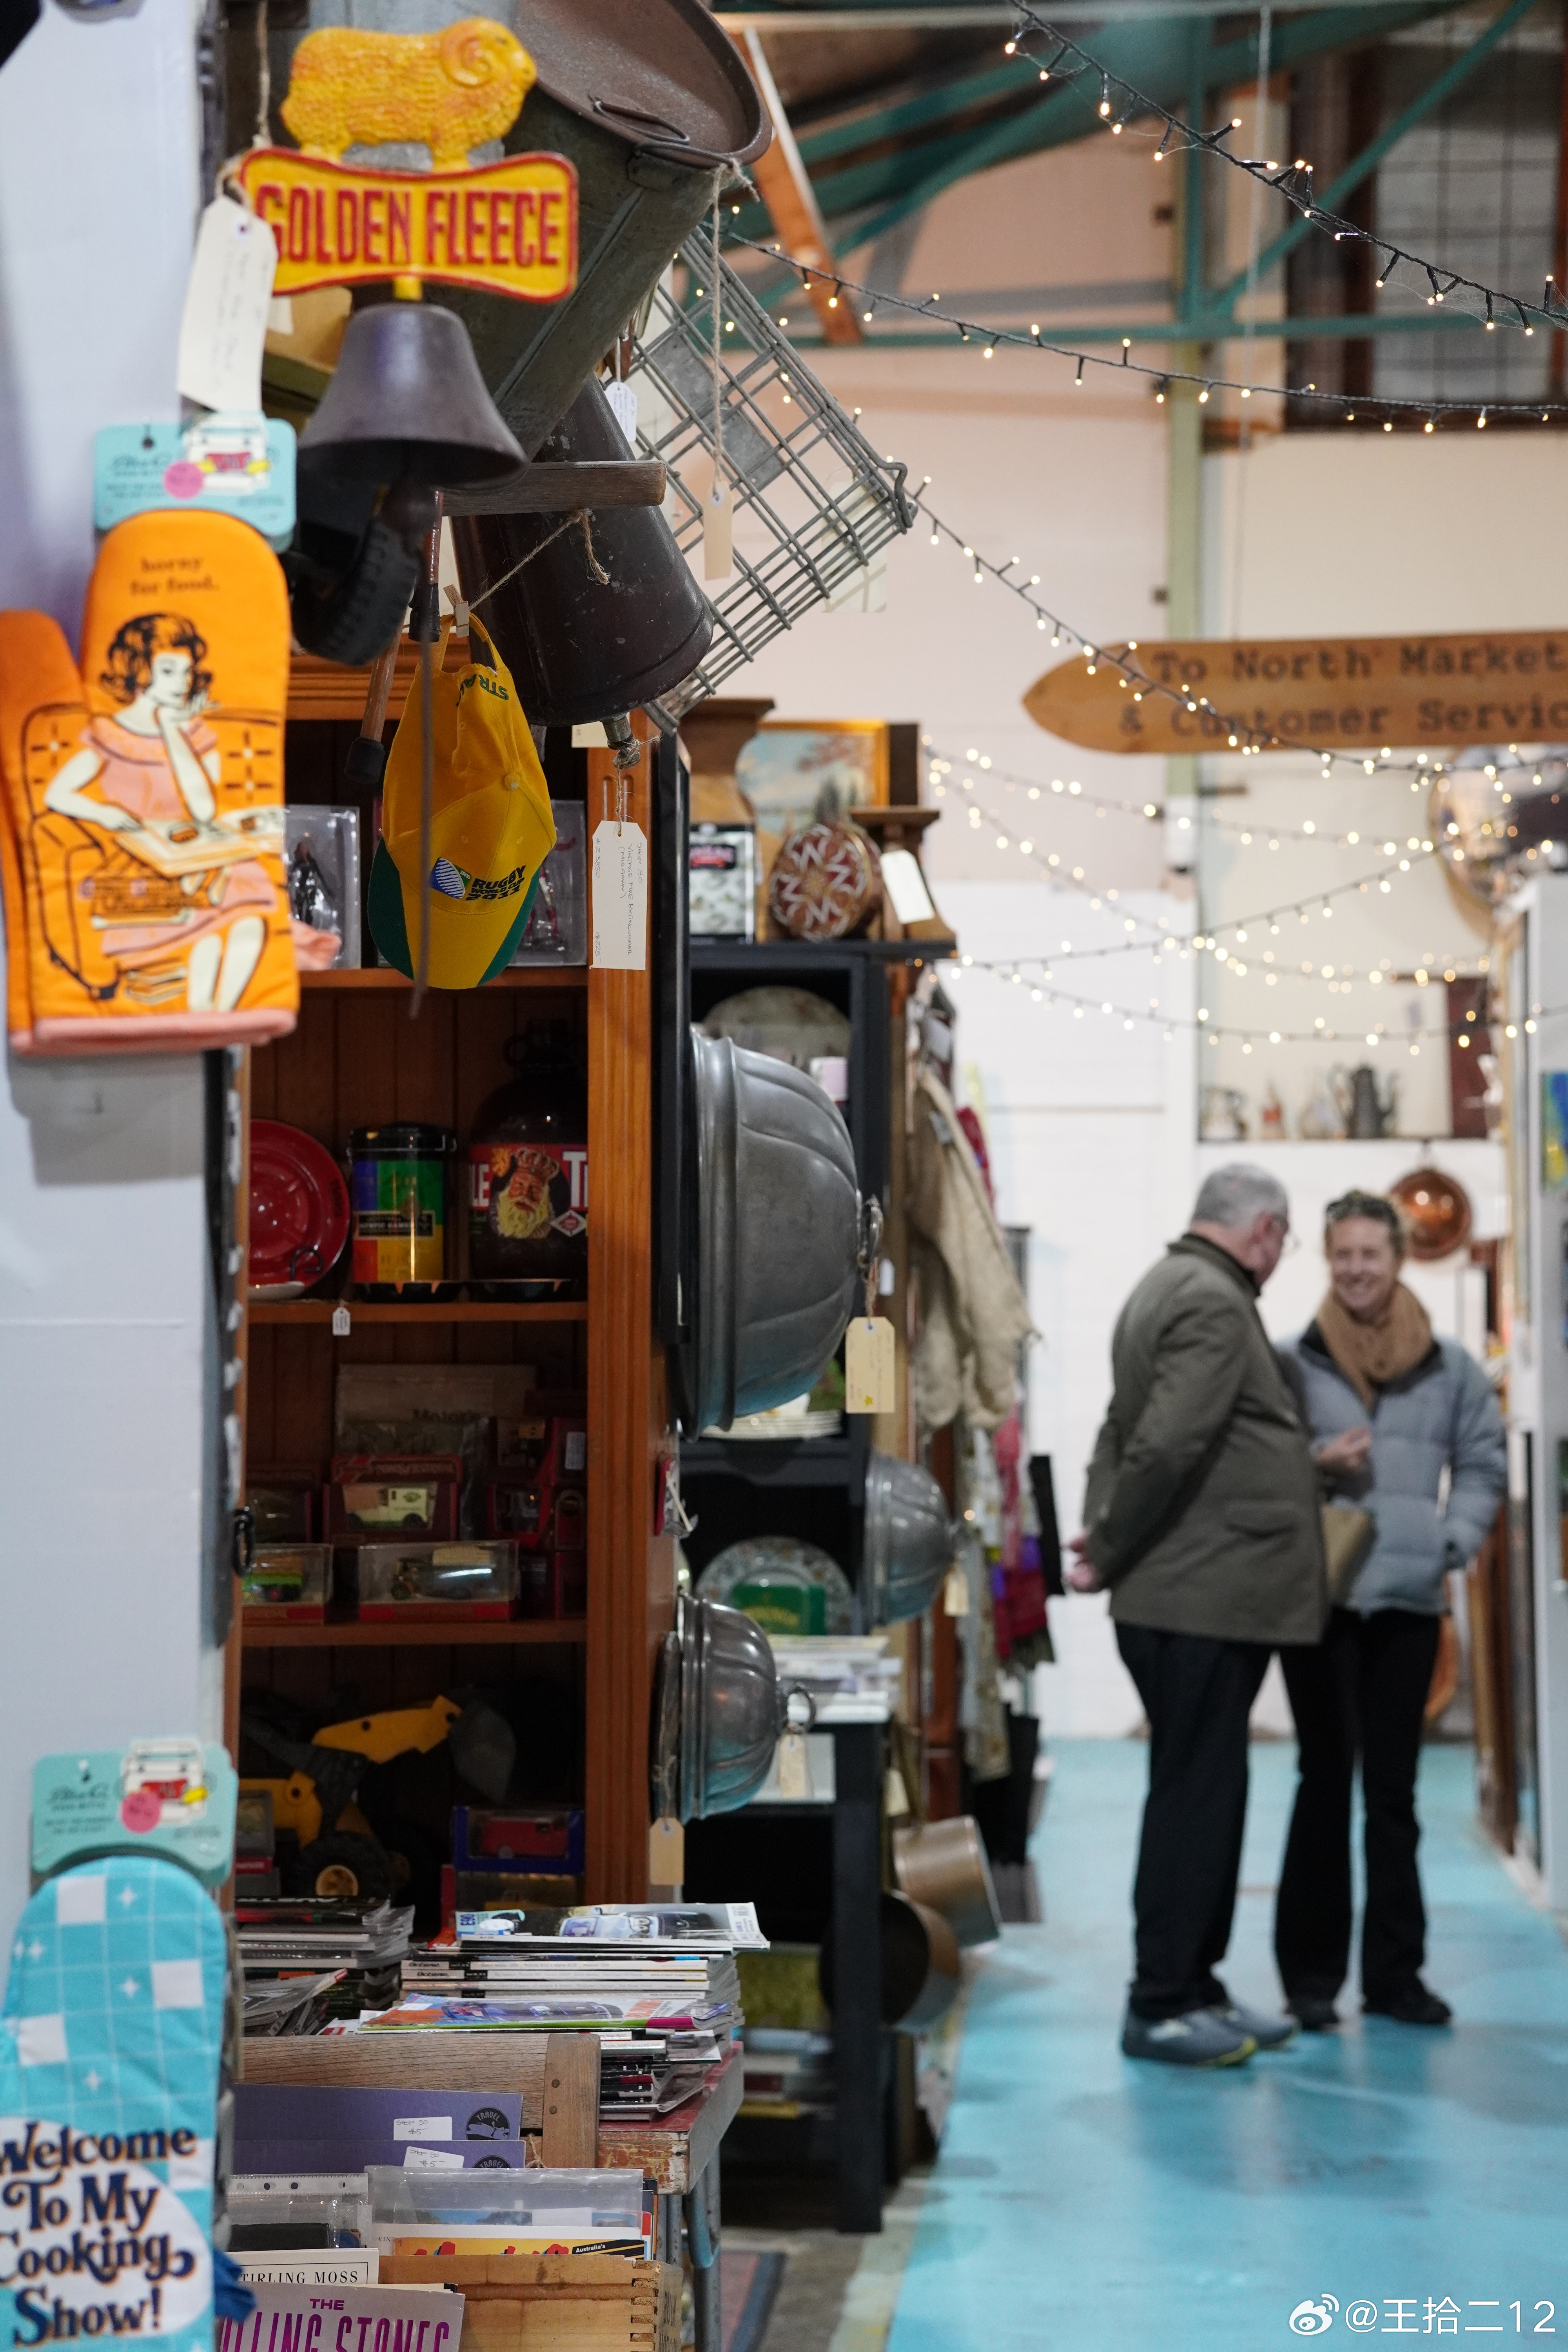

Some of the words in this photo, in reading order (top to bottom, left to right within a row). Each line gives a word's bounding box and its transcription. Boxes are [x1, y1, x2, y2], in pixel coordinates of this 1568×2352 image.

[255, 184, 412, 265] GOLDEN
[426, 190, 563, 267] FLEECE
[1152, 650, 1208, 684] To
[1233, 645, 1371, 682] North
[1400, 639, 1568, 677] Market
[1118, 705, 1144, 736] &
[472, 865, 526, 889] RUGBY
[508, 877, 525, 889] CUP
[465, 884, 521, 901] 2011
[476, 2111, 500, 2122] TRAVEL
[0, 2121, 198, 2175] Welcome
[409, 2148, 427, 2156] SHOP
[2, 2172, 69, 2230] To
[81, 2171, 159, 2232] My
[0, 2227, 196, 2284] ooking
[575, 2243, 606, 2253] Australia's
[241, 2272, 305, 2284] TIRLING
[314, 2271, 358, 2284] MOSS
[14, 2285, 163, 2347] Show!
[309, 2298, 345, 2311] THE
